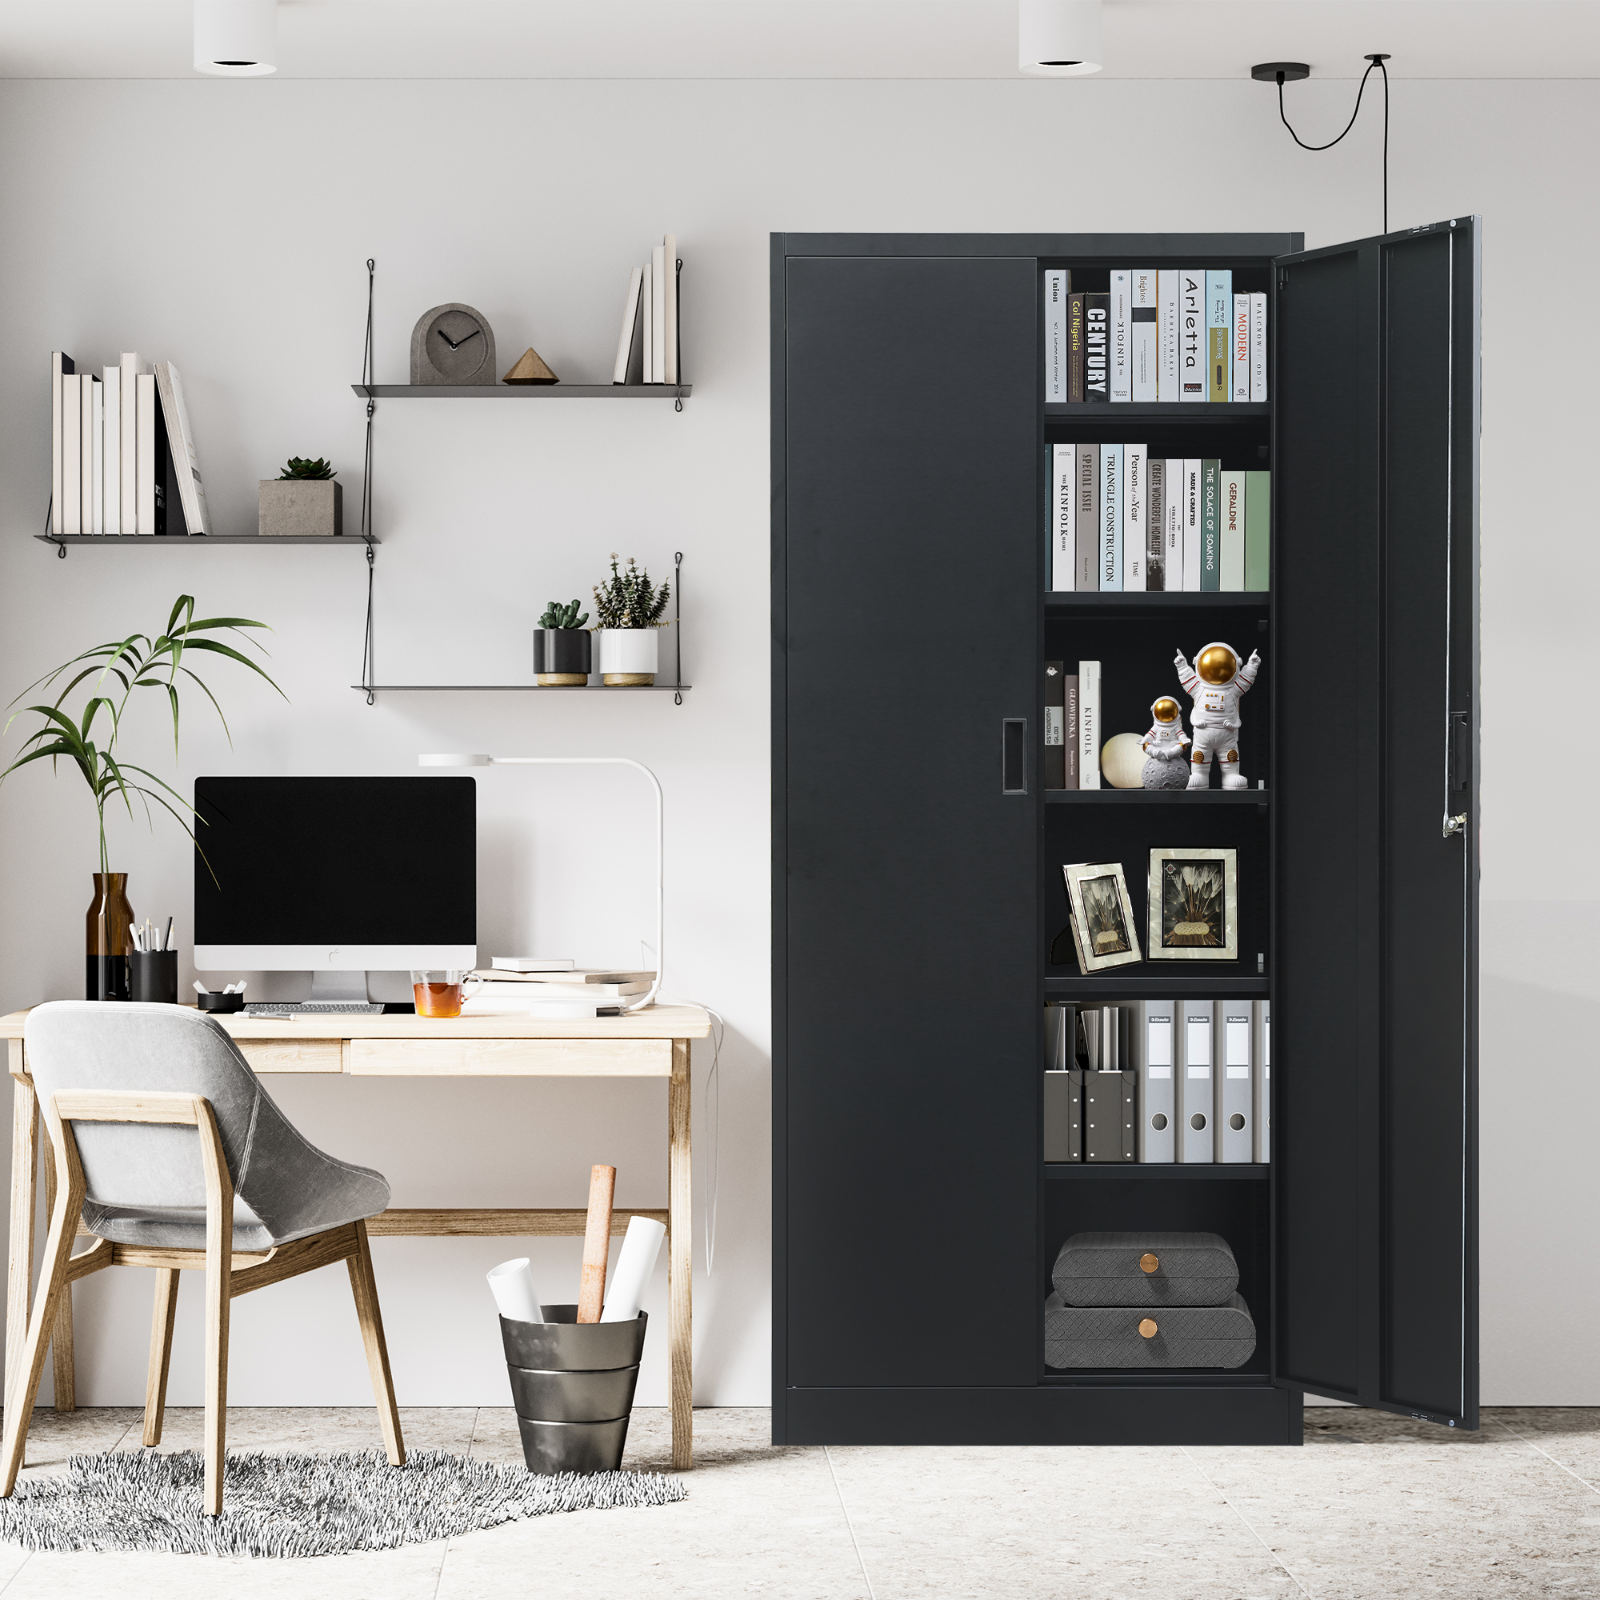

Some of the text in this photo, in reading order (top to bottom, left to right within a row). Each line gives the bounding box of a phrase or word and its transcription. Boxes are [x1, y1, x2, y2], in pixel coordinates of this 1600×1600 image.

[1052, 277, 1060, 303] Union
[1072, 301, 1081, 316] Col
[1138, 275, 1148, 304] Brightest
[1070, 318, 1081, 351] Nigeria
[1117, 321, 1125, 367] KINFOLK
[1185, 278, 1200, 368] Arletta
[1237, 313, 1247, 361] MODERN
[1087, 308, 1107, 393] CENTURY
[1082, 454, 1092, 513] SPECIAL ISSUE
[1131, 454, 1140, 487] Person
[1060, 485, 1069, 537] KINFOLK
[1105, 454, 1116, 582] TRIANGLE CONSTRUCTION
[1131, 501, 1140, 522] Year
[1151, 463, 1162, 556] CREATE WONDERFUL HOMELIFE
[1206, 467, 1214, 571] THE SOLACE OF SOAKING
[1228, 482, 1238, 531] GERALDINE
[1084, 707, 1092, 756] KINFOLK
